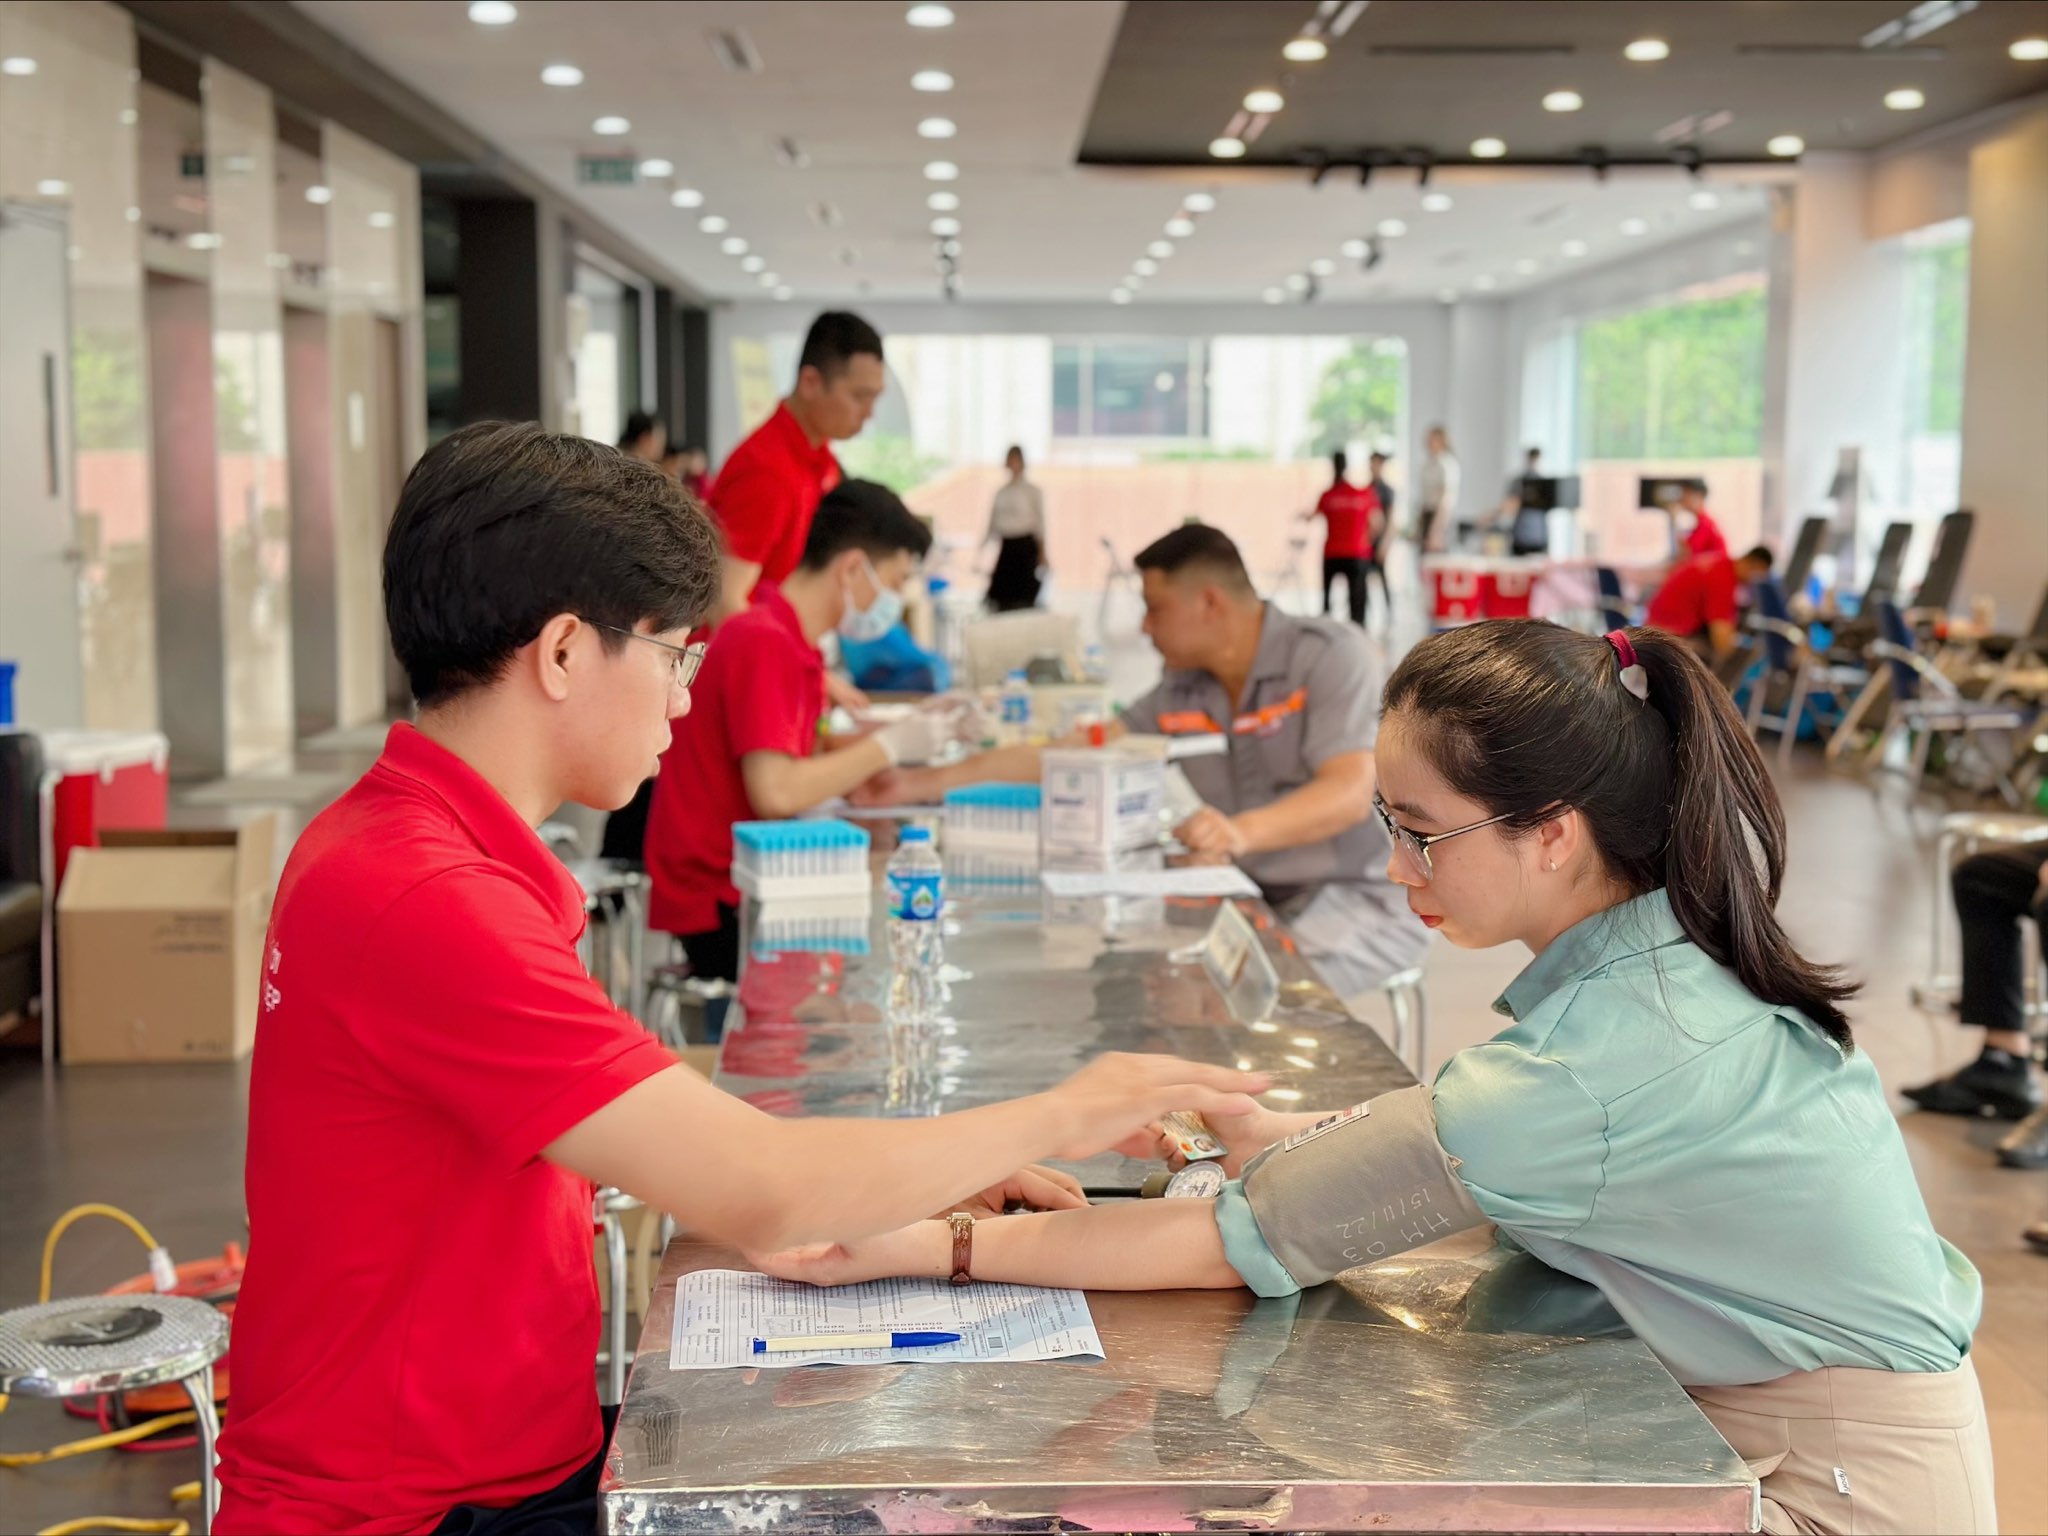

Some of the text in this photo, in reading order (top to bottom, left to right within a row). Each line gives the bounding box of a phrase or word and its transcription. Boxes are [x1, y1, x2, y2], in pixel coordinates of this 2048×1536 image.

[1335, 1188, 1431, 1239] 15/11/22
[1342, 1212, 1452, 1263] HM 03
